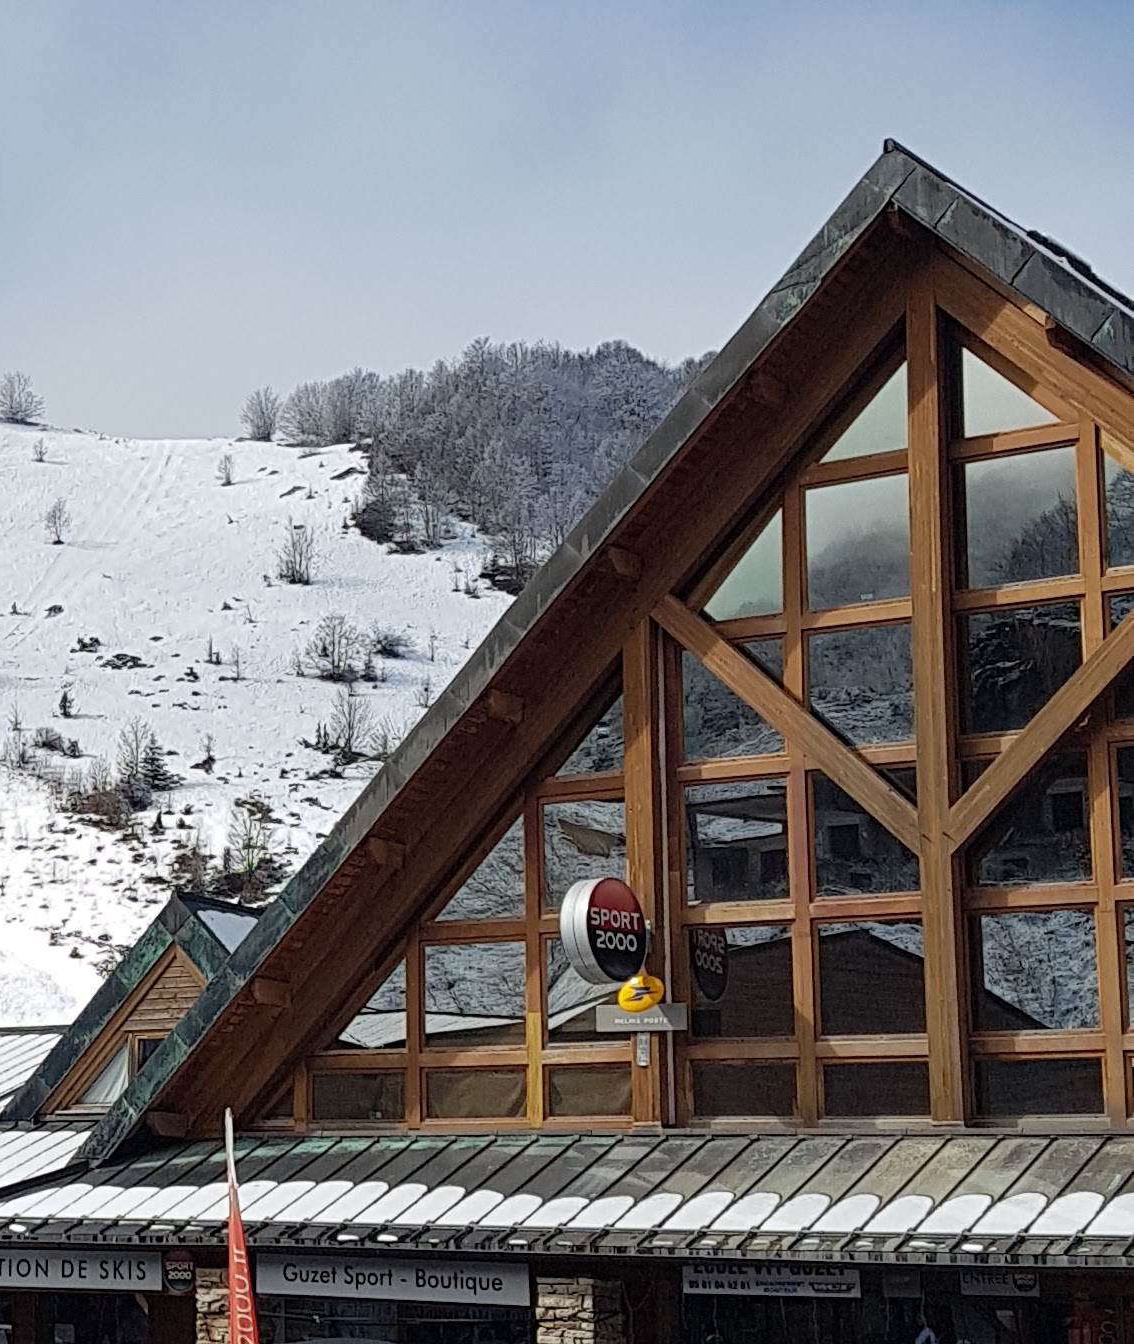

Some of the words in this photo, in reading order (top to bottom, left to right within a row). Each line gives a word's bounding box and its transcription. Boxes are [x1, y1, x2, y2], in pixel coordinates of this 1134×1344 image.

[590, 906, 641, 931] SPORT
[595, 929, 638, 952] 2000
[60, 1259, 88, 1279] DE
[98, 1259, 147, 1281] SKIS
[165, 1261, 194, 1271] SPORT
[167, 1270, 193, 1281] 2000
[282, 1262, 338, 1285] Guzet
[343, 1264, 394, 1290] Sport
[415, 1267, 504, 1295] Boutique
